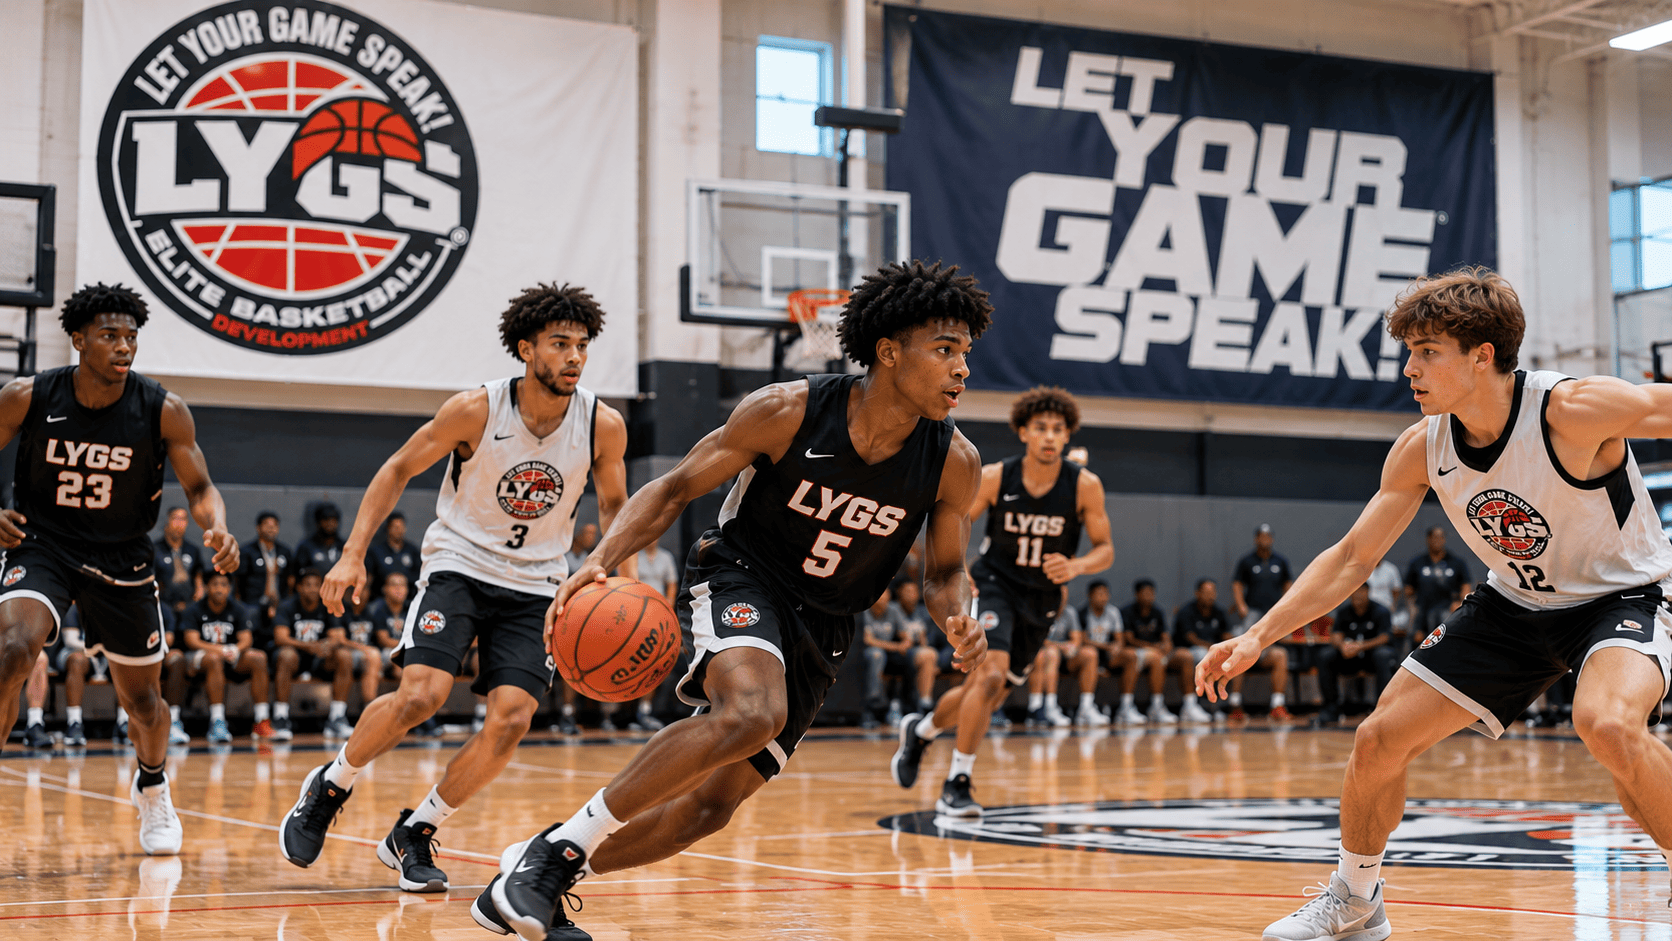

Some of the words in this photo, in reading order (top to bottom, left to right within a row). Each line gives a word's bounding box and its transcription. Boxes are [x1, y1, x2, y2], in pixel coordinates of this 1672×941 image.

[134, 44, 189, 105] LET
[178, 9, 264, 64] YOUR
[268, 6, 360, 56] GAME
[356, 34, 455, 134] SPEAK!
[1010, 46, 1175, 116] LET
[132, 120, 461, 236] LYGS
[1097, 112, 1408, 208] YOUR
[995, 171, 1437, 310] GAME
[145, 229, 226, 308] ELITE
[231, 251, 432, 329] BASKETBALL
[211, 314, 370, 349] DEVELOPMENT
[1049, 285, 1402, 382] SPEAK!
[46, 439, 133, 471] LYGS
[56, 471, 113, 509] 23
[787, 479, 907, 537] LYGS
[505, 524, 529, 549] 3
[1004, 511, 1066, 537] LYGS
[1469, 516, 1548, 538] LYGS
[802, 529, 853, 578] 5
[1016, 537, 1044, 567] 11
[1507, 561, 1556, 592] 12
